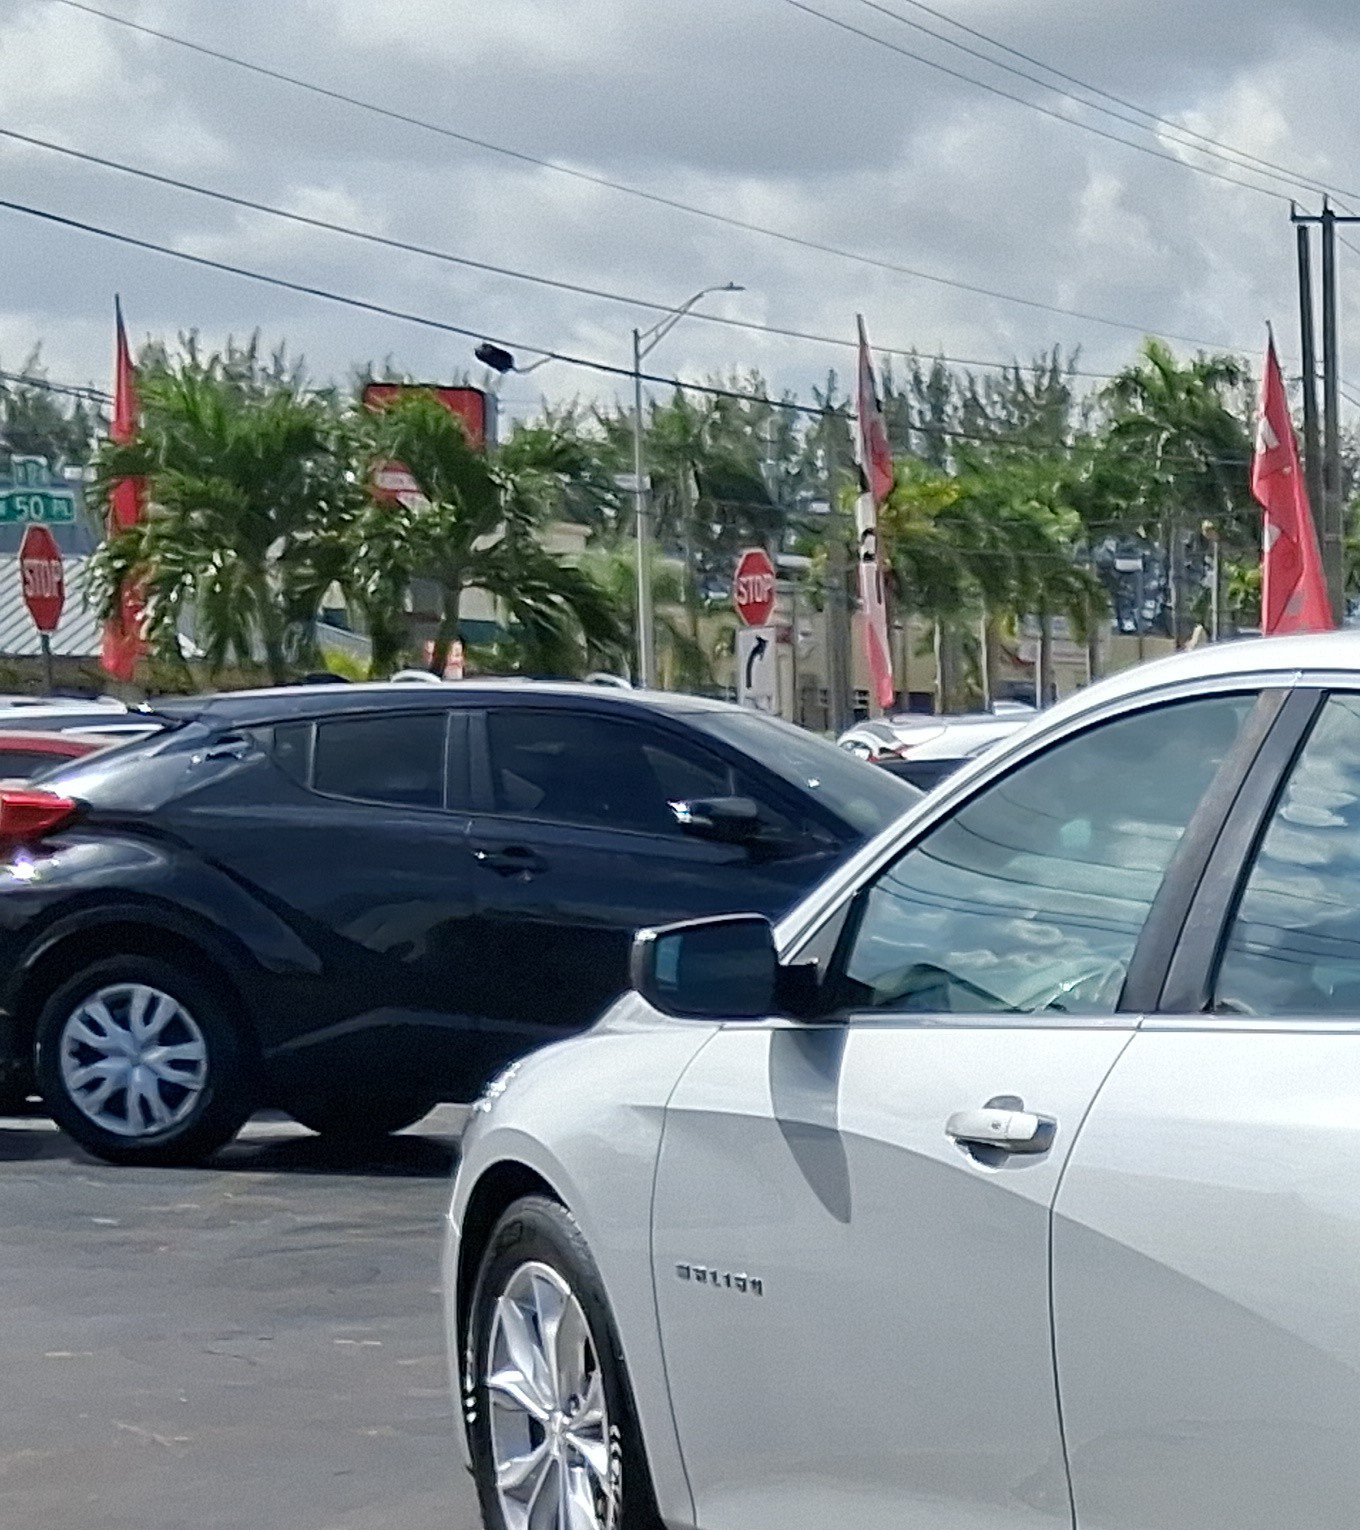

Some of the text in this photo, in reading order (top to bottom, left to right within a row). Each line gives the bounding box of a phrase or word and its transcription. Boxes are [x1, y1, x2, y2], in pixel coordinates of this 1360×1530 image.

[16, 496, 44, 520] 50
[23, 560, 62, 597] STOP
[736, 574, 772, 605] STOP
